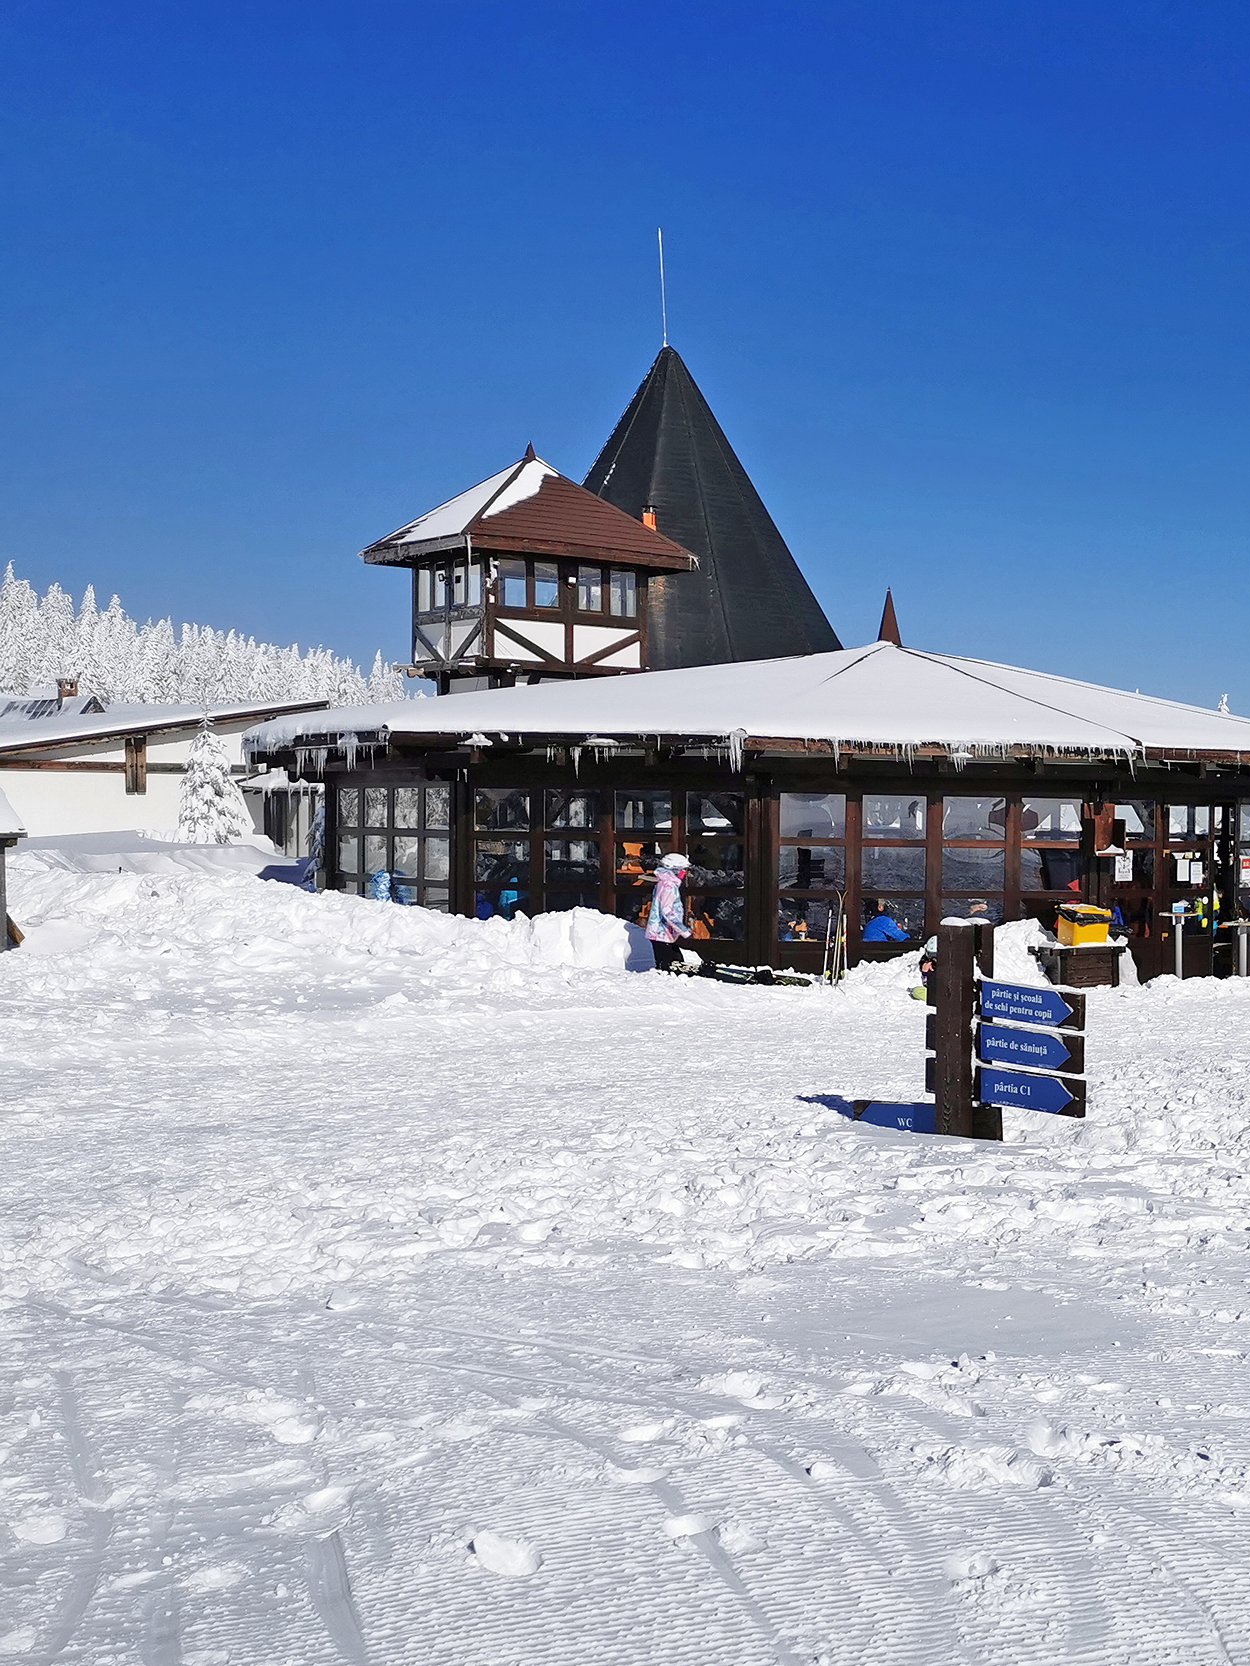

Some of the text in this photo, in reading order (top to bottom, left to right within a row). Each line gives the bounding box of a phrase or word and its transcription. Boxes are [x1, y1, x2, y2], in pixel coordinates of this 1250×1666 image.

[991, 988, 1012, 999] pârtie
[1020, 994, 1043, 1004] școală
[984, 1000, 1052, 1020] de schi pentru copii
[985, 1037, 1008, 1048] pârtie
[1009, 1040, 1019, 1050] de
[994, 1081, 1031, 1096] pârtia C1
[897, 1117, 913, 1128] WC
